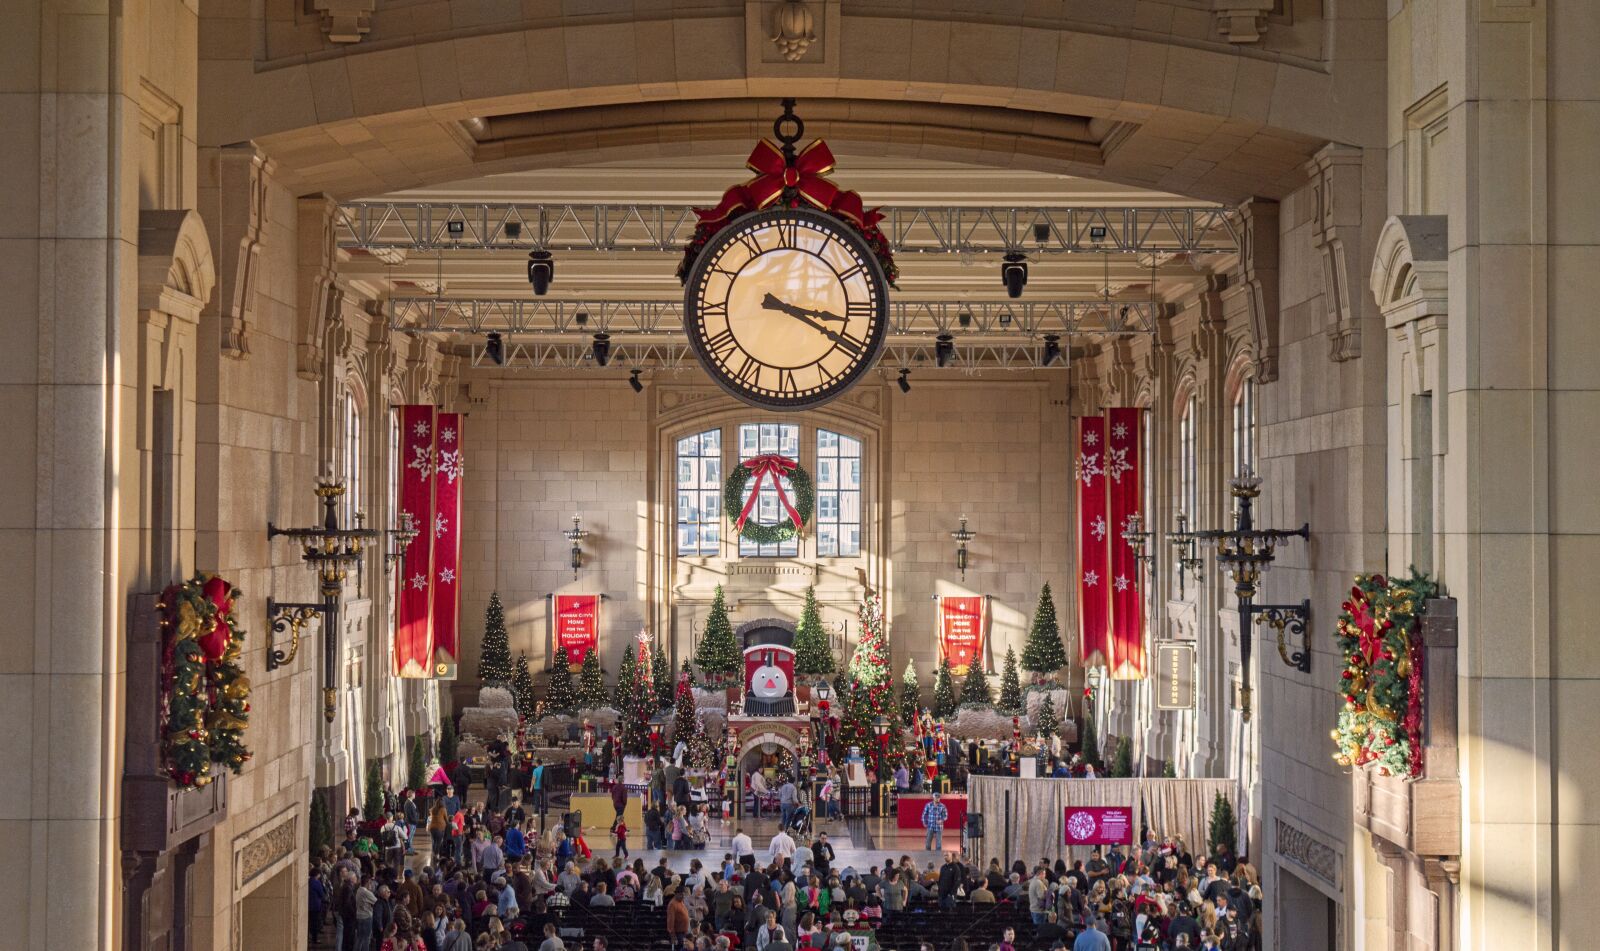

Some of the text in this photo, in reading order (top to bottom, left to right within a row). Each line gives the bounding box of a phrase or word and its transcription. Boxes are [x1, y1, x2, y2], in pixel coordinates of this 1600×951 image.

[740, 232, 763, 258] XI
[778, 224, 797, 249] XII
[818, 233, 832, 258] I
[713, 263, 737, 280] X
[839, 264, 862, 282] II
[703, 300, 727, 316] IX
[848, 301, 872, 317] III
[708, 329, 737, 363] VIII
[835, 332, 865, 360] II
[737, 357, 761, 387] VII
[778, 368, 798, 393] VI
[817, 361, 836, 385] V
